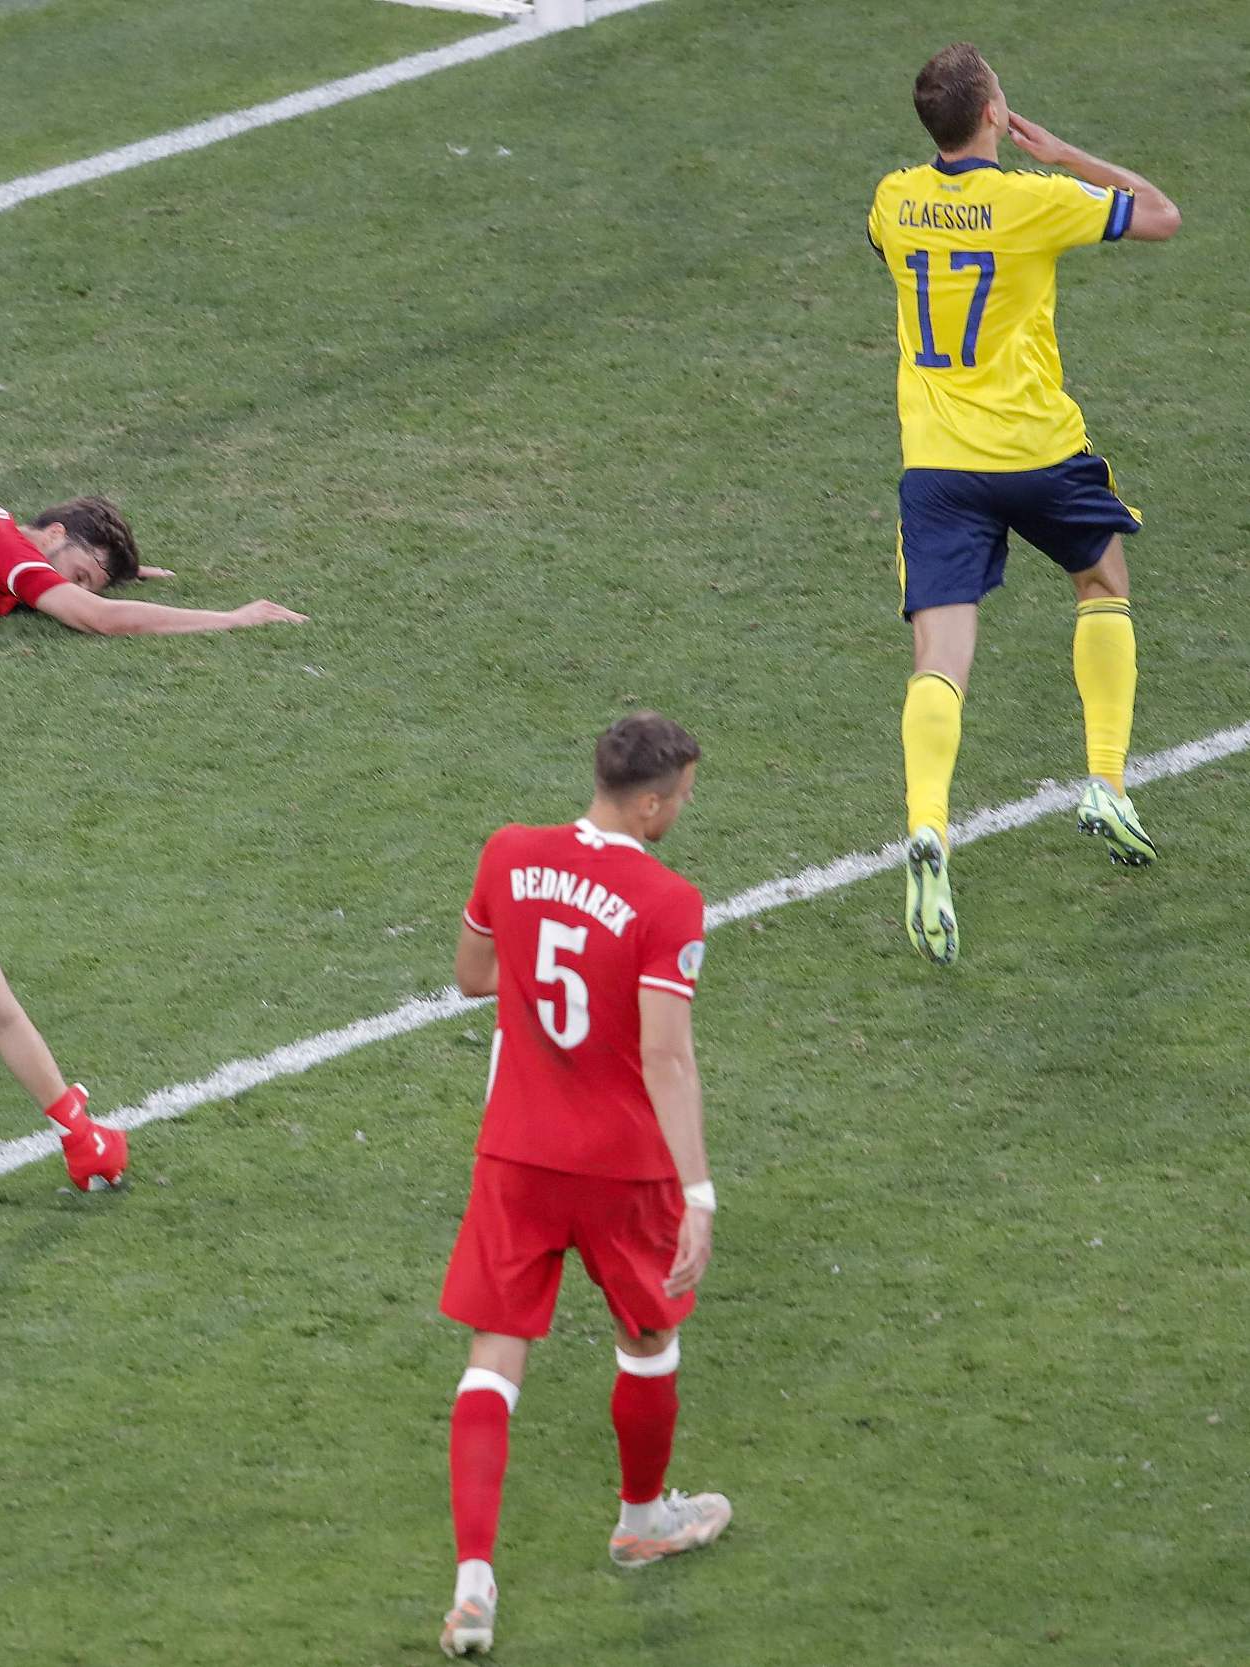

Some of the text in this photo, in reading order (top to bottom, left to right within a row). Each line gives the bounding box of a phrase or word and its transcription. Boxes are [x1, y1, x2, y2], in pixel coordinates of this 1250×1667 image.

[898, 199, 992, 232] CLAESSON
[905, 249, 996, 368] 17
[509, 865, 638, 938] BEDNAREK
[534, 917, 591, 1050] 5
